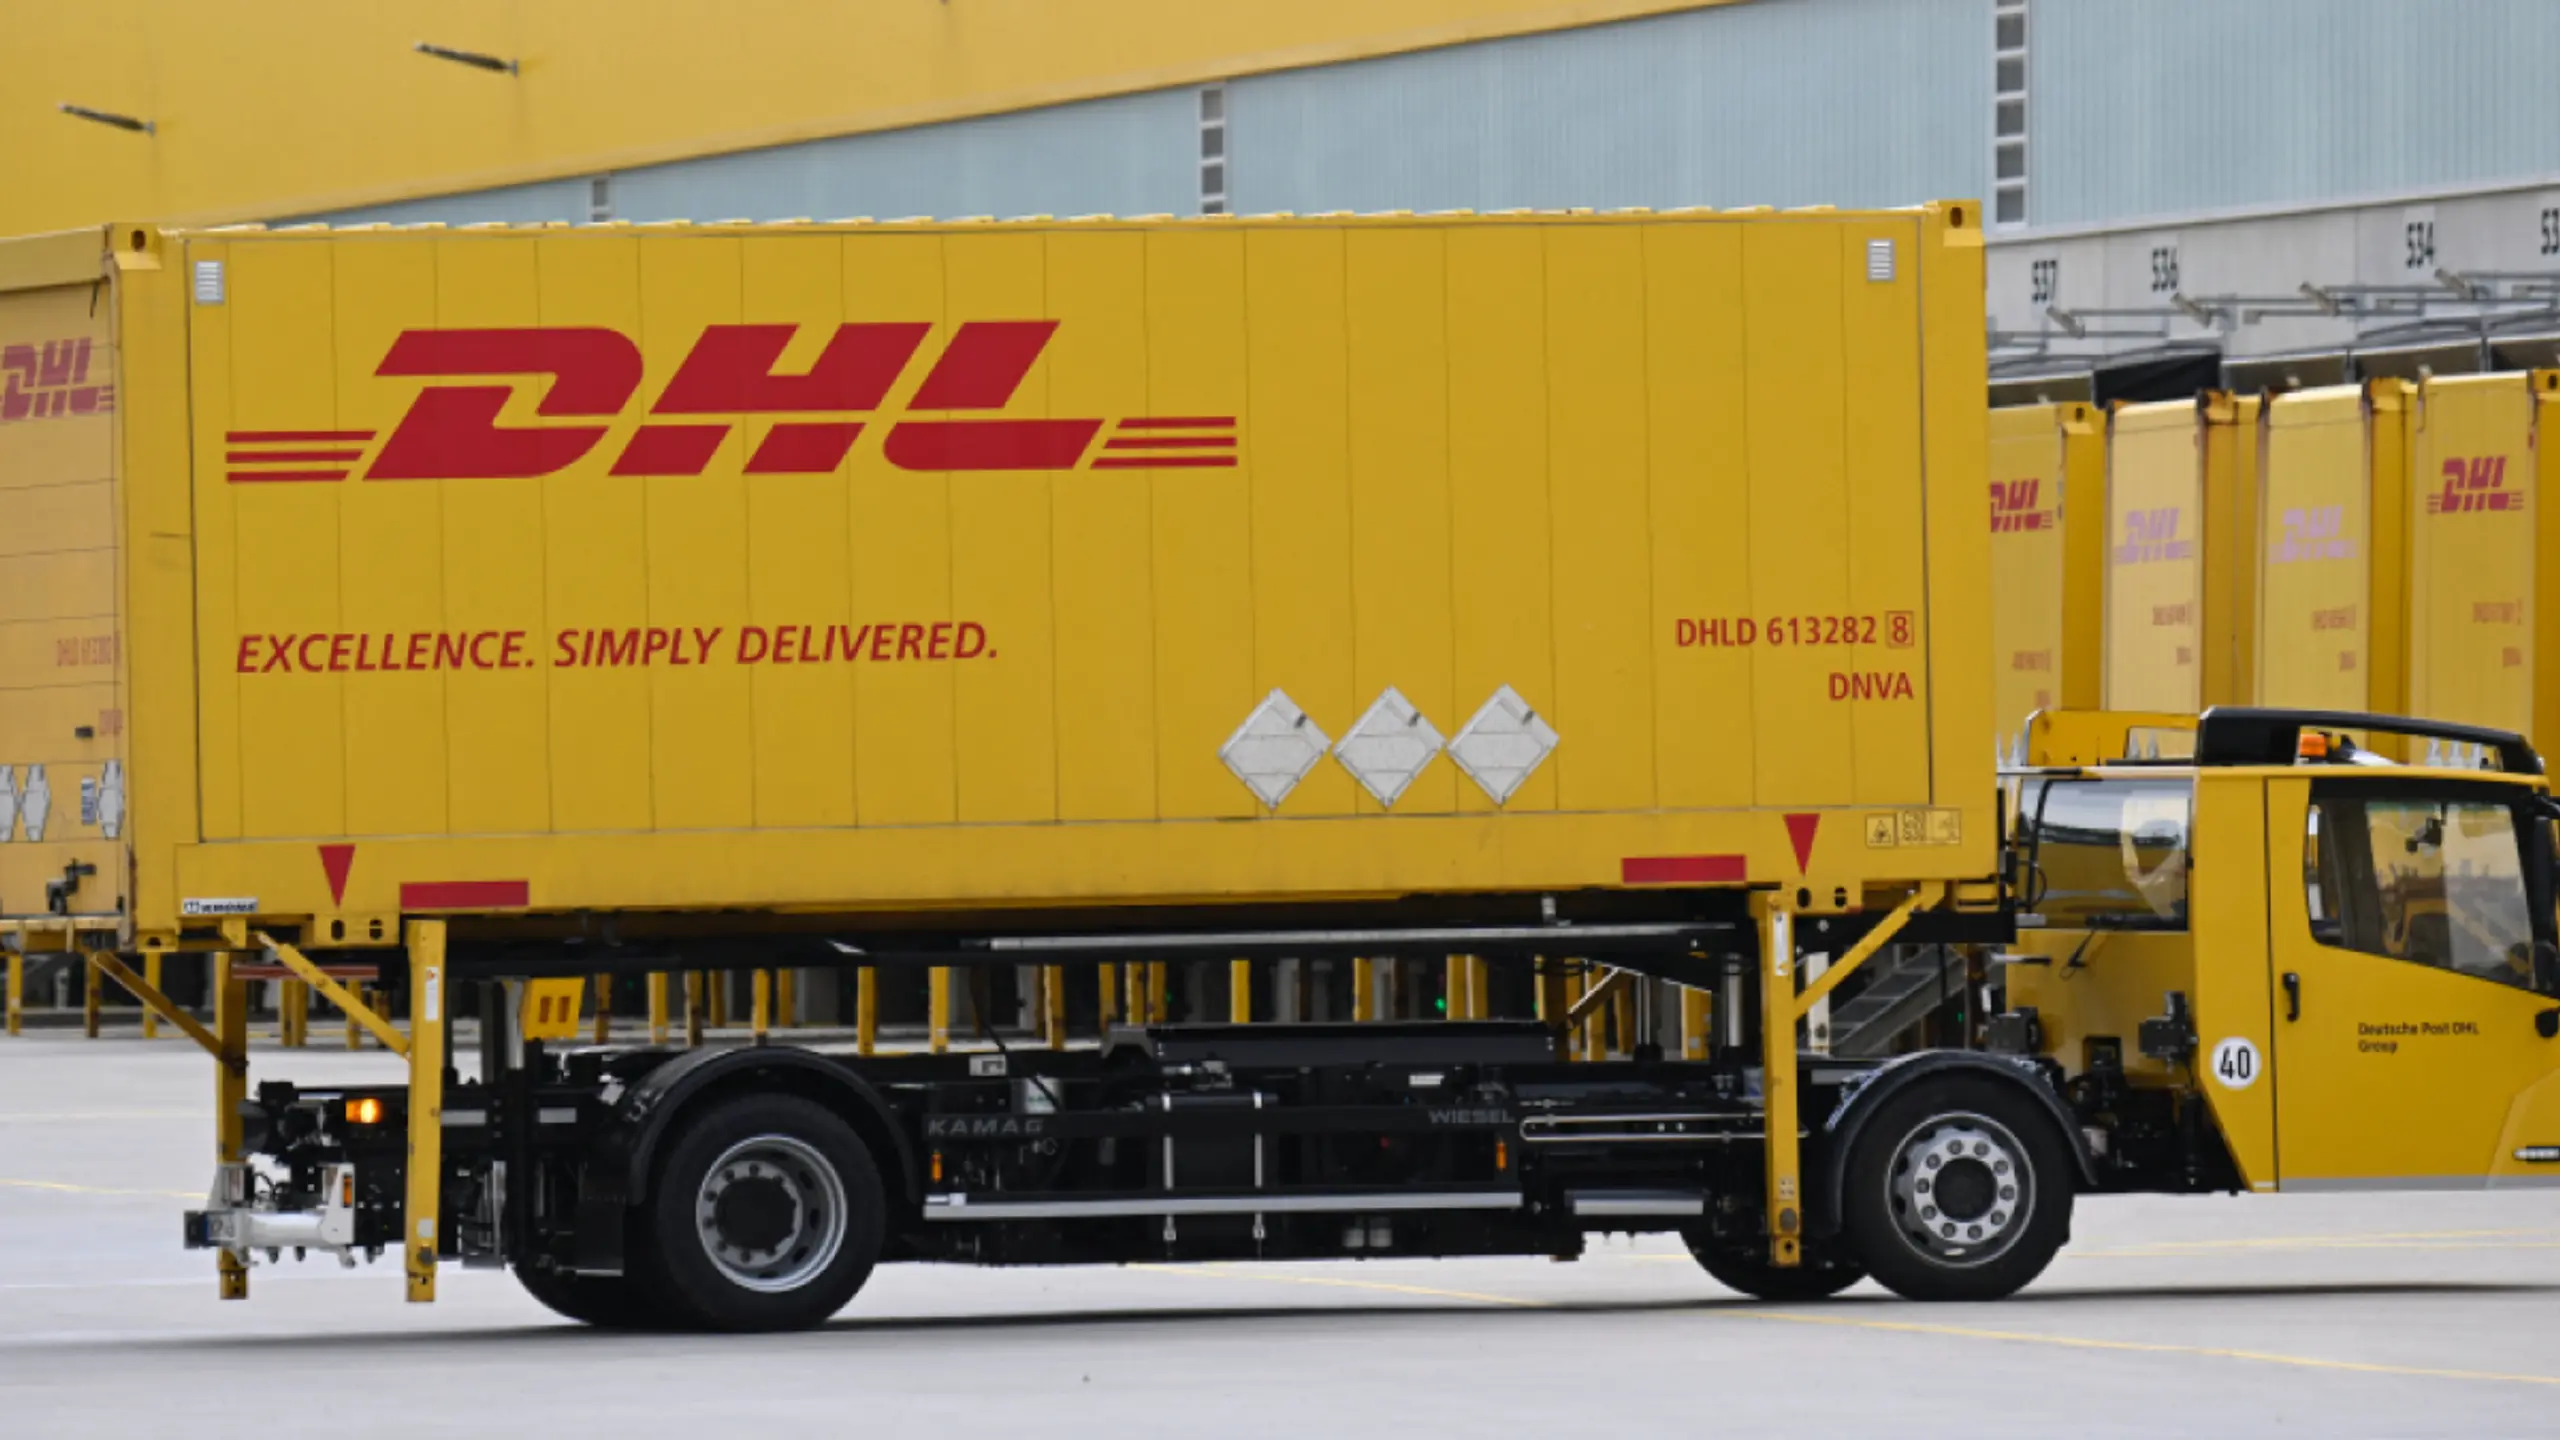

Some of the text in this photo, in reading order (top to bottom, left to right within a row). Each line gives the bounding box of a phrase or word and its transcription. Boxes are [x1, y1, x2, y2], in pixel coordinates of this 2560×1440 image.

[2406, 221, 2435, 268] 534
[2541, 208, 2559, 254] 53
[2032, 260, 2057, 303] 537
[2152, 248, 2177, 291] 536
[2, 336, 98, 420] DHL
[363, 319, 1105, 481] DHL
[2440, 455, 2510, 513] DHL
[2121, 507, 2183, 564] DHL
[2280, 504, 2344, 563] DHL
[236, 621, 998, 673] EXCELLENCE. SIMPLY DELIVERED.
[1675, 614, 1910, 648] DHLD 613282 8
[1828, 671, 1915, 701] DNVA
[2358, 1021, 2480, 1036] Deutsche Post DHL
[2358, 1039, 2398, 1055] Group
[2219, 1045, 2252, 1080] 40
[927, 1117, 1044, 1137] KAMAG
[1428, 1108, 1516, 1124] WIESEL
